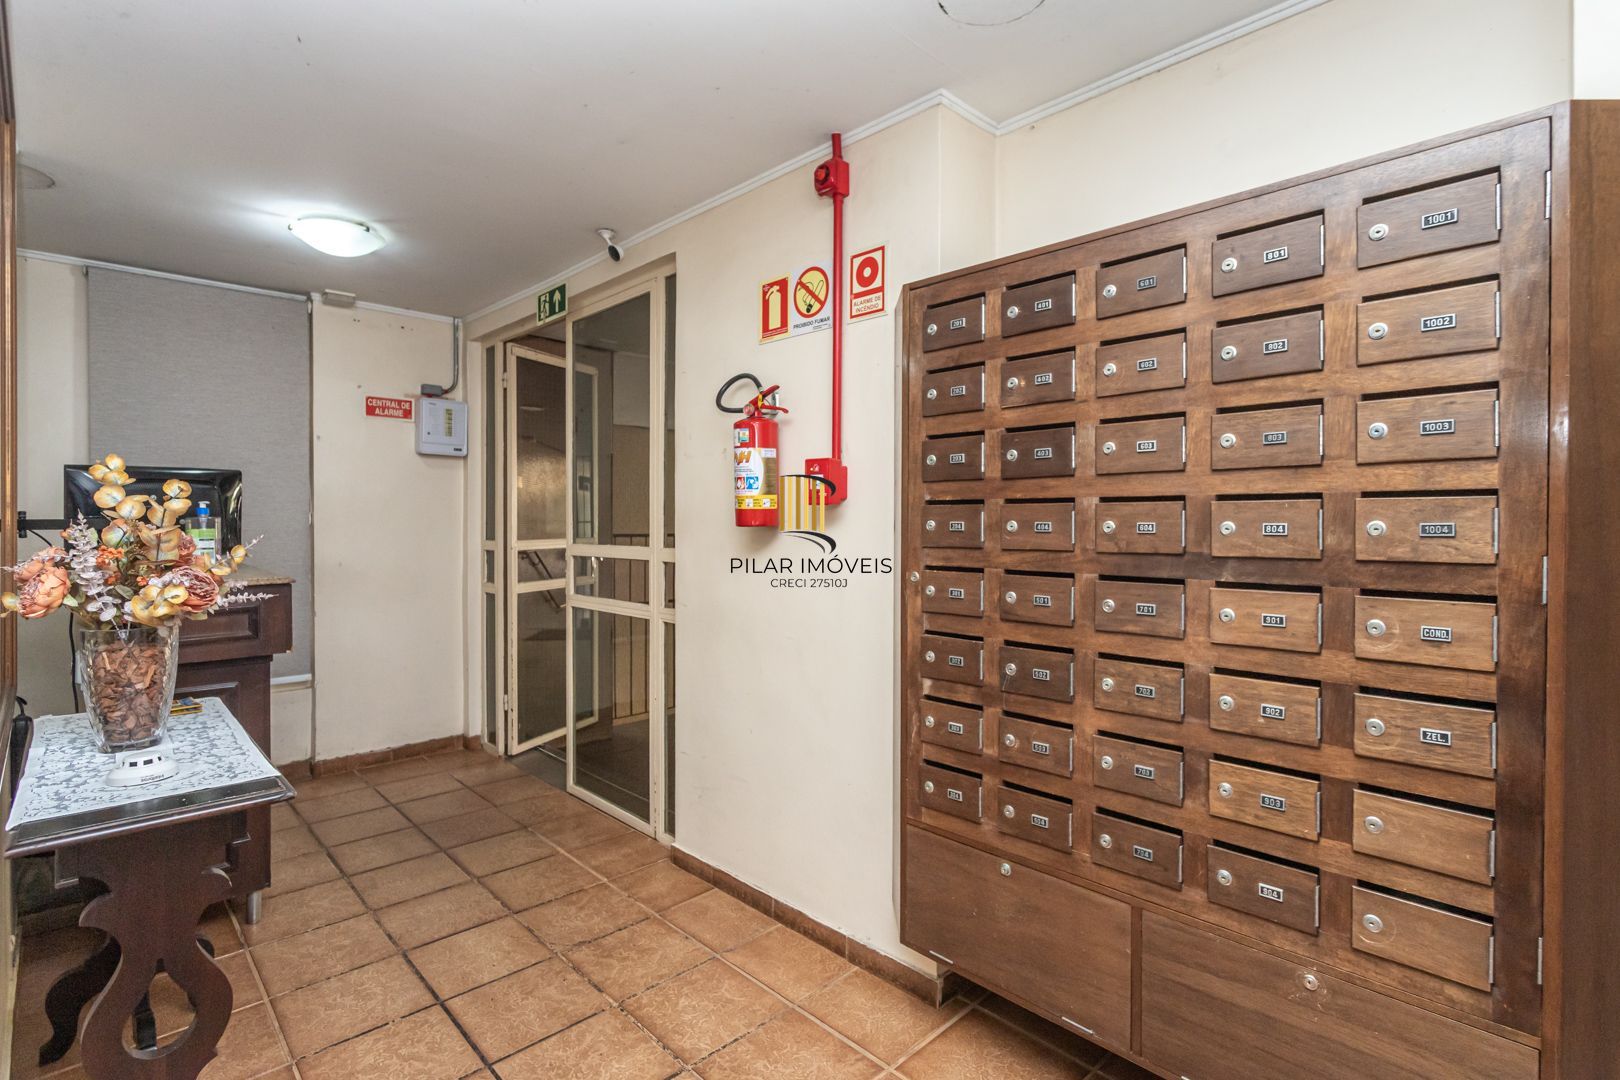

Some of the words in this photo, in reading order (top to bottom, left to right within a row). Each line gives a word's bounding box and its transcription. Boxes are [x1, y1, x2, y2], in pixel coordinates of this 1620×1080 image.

[1426, 211, 1453, 225] 1001
[1266, 248, 1286, 261] 801
[1139, 277, 1154, 288] 601
[854, 297, 873, 307] ALARME
[1036, 300, 1050, 310] 401
[855, 302, 880, 313] INCÊNDIO
[793, 320, 814, 330] PROIBIDO
[814, 316, 831, 325] FUMAR
[1424, 316, 1451, 329] 1002
[1267, 341, 1284, 351] 802
[1139, 359, 1154, 369] 602
[1036, 374, 1050, 383] 402
[367, 398, 399, 409] CENTRAL
[401, 401, 411, 410] DE
[375, 407, 404, 417] ALARME
[1423, 421, 1450, 432] 1003
[1266, 432, 1283, 442] 803
[1139, 441, 1154, 451] 603
[1036, 448, 1050, 458] 403
[1036, 523, 1050, 531] 404
[1265, 524, 1284, 533] 804
[1423, 524, 1450, 535] 1004
[1035, 596, 1049, 605] 501
[1138, 605, 1153, 614] 701
[1264, 615, 1281, 625] 901
[1422, 627, 1450, 640] COND.
[1034, 670, 1048, 679] 502
[1137, 686, 1152, 696] 702
[1264, 706, 1281, 717] 902
[1424, 731, 1447, 744] ZEL.
[1137, 767, 1151, 777] 703
[1263, 796, 1282, 809] 903
[1135, 848, 1150, 859] 704
